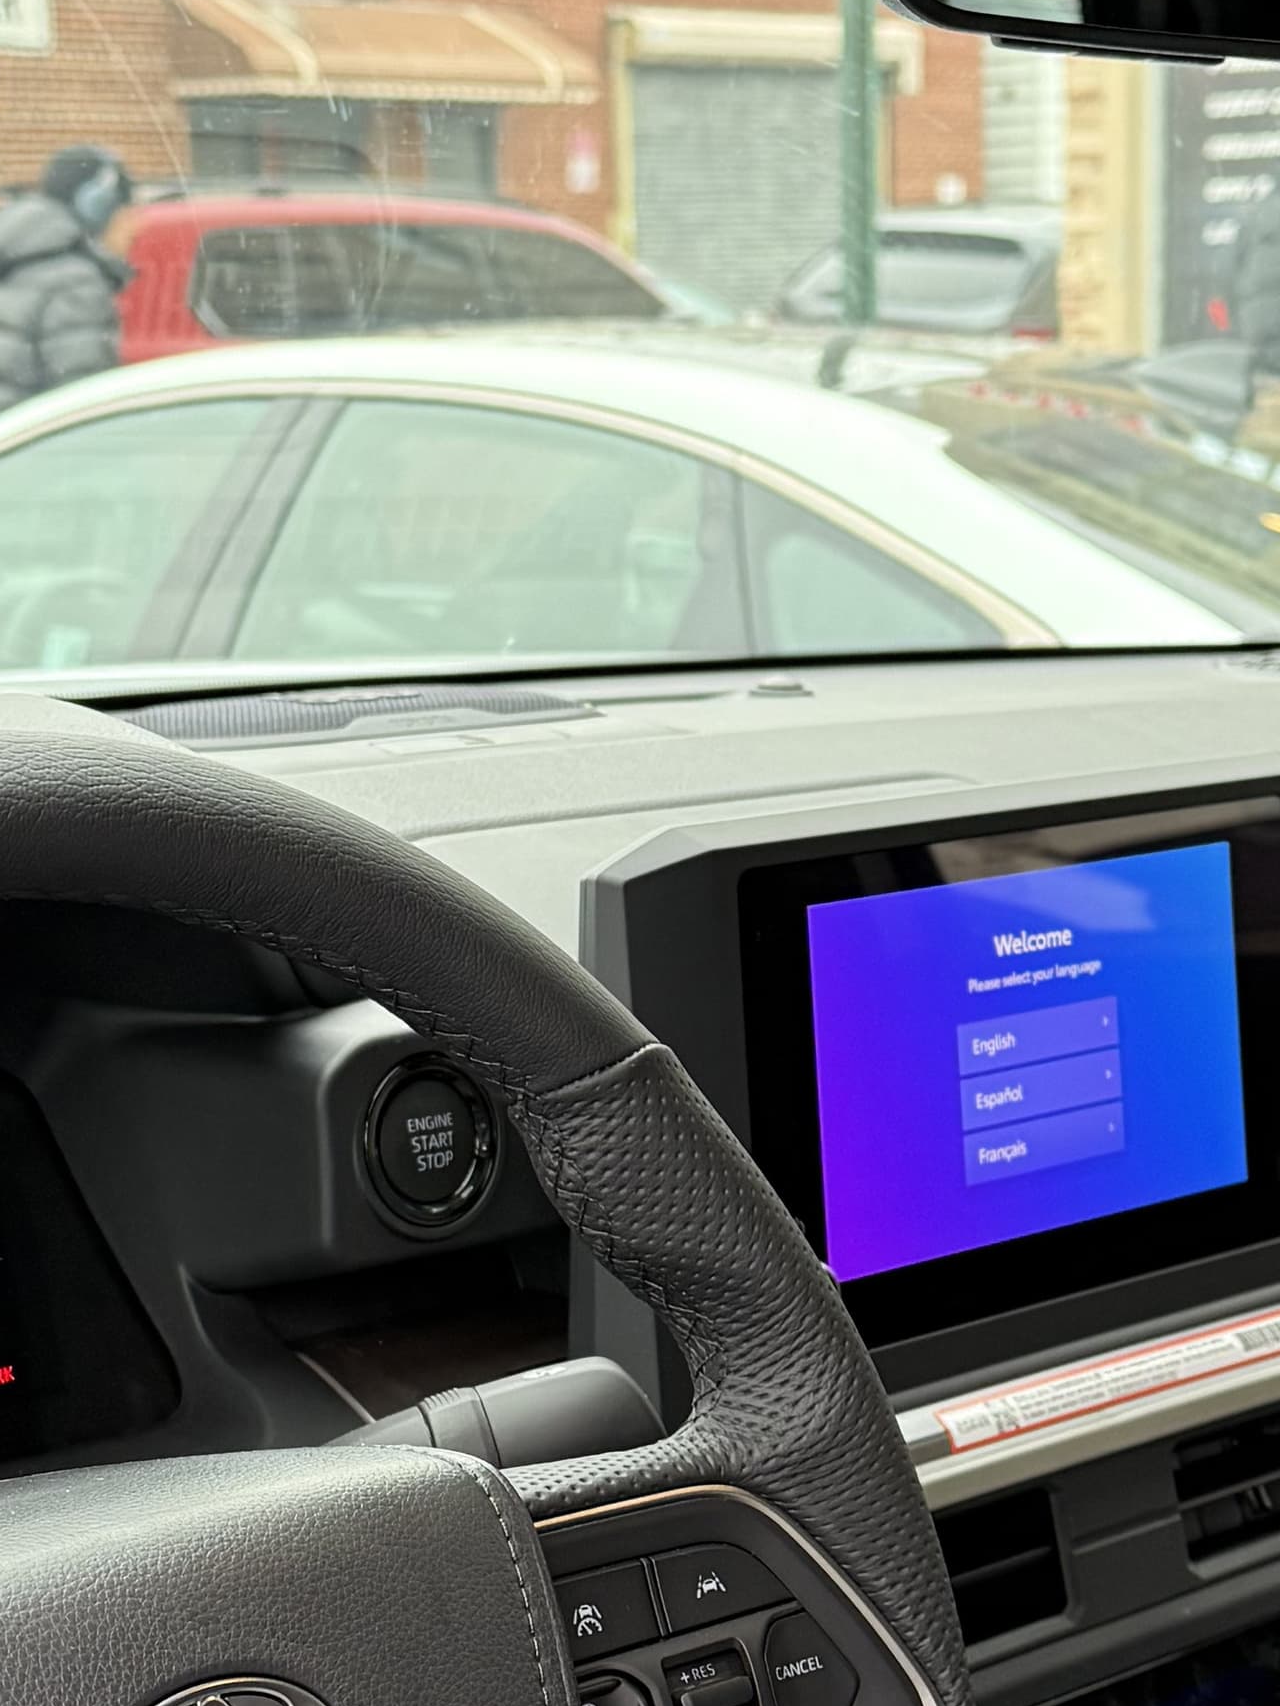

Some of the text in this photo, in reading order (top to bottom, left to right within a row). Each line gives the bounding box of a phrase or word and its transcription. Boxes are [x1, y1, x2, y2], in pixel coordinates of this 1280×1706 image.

[993, 928, 1072, 957] Welcome
[967, 959, 1101, 993] Please select your language
[972, 1032, 1016, 1056] English
[975, 1085, 1024, 1110] Español
[407, 1112, 454, 1133] ENGINE
[411, 1130, 454, 1154] START
[978, 1141, 1027, 1165] Français
[417, 1150, 454, 1172] STOP
[775, 1656, 823, 1681] CANCEL
